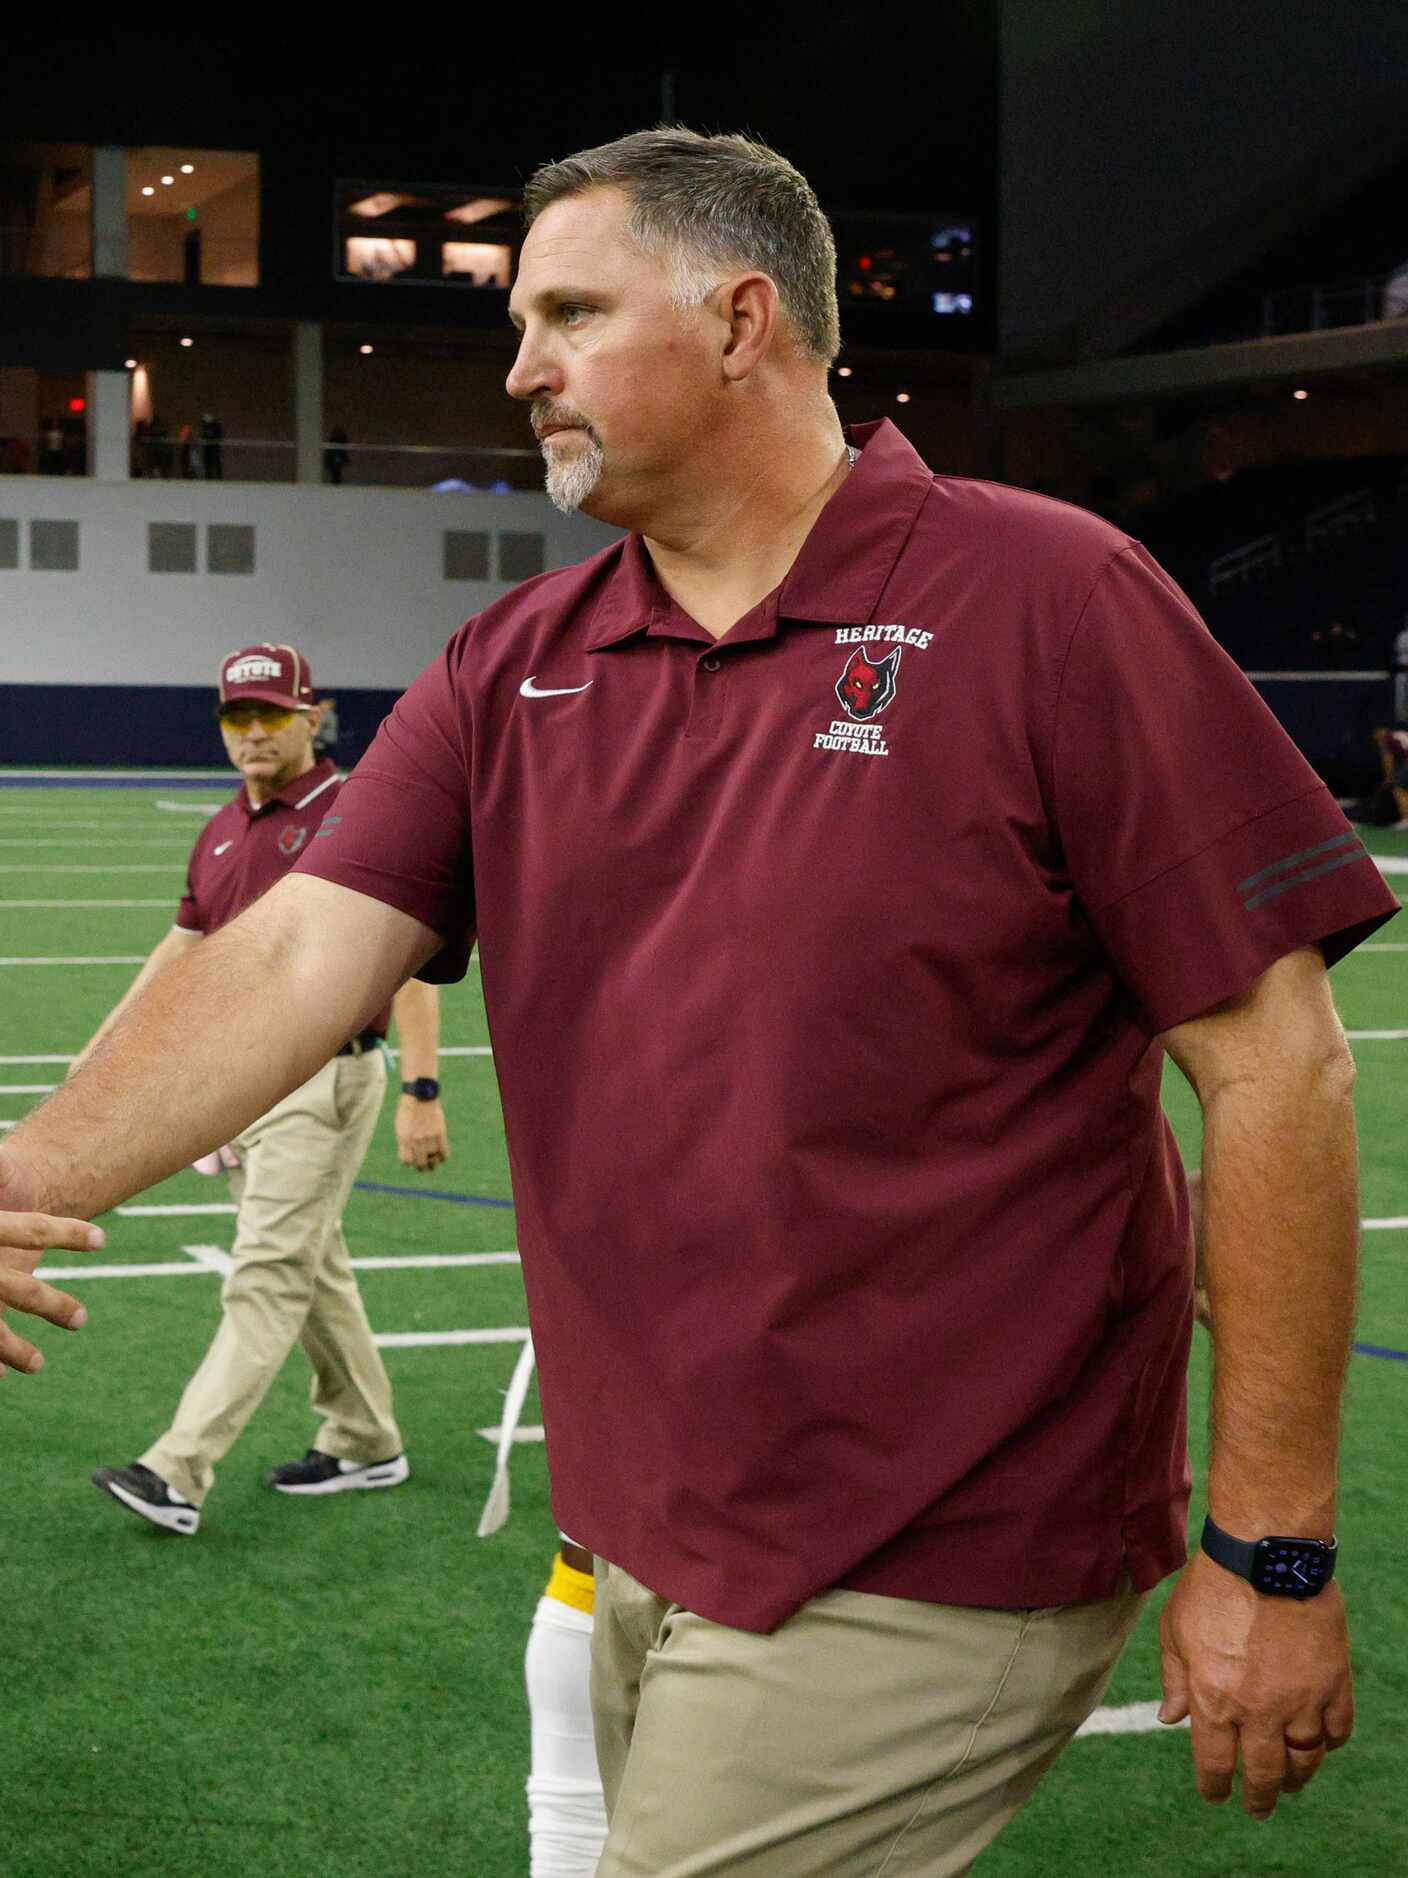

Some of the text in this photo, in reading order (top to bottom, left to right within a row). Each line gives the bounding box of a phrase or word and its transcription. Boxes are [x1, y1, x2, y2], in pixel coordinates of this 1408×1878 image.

[835, 625, 933, 649] HERITAGE
[829, 721, 883, 739] COYOTE
[813, 733, 888, 755] FOOTBALL
